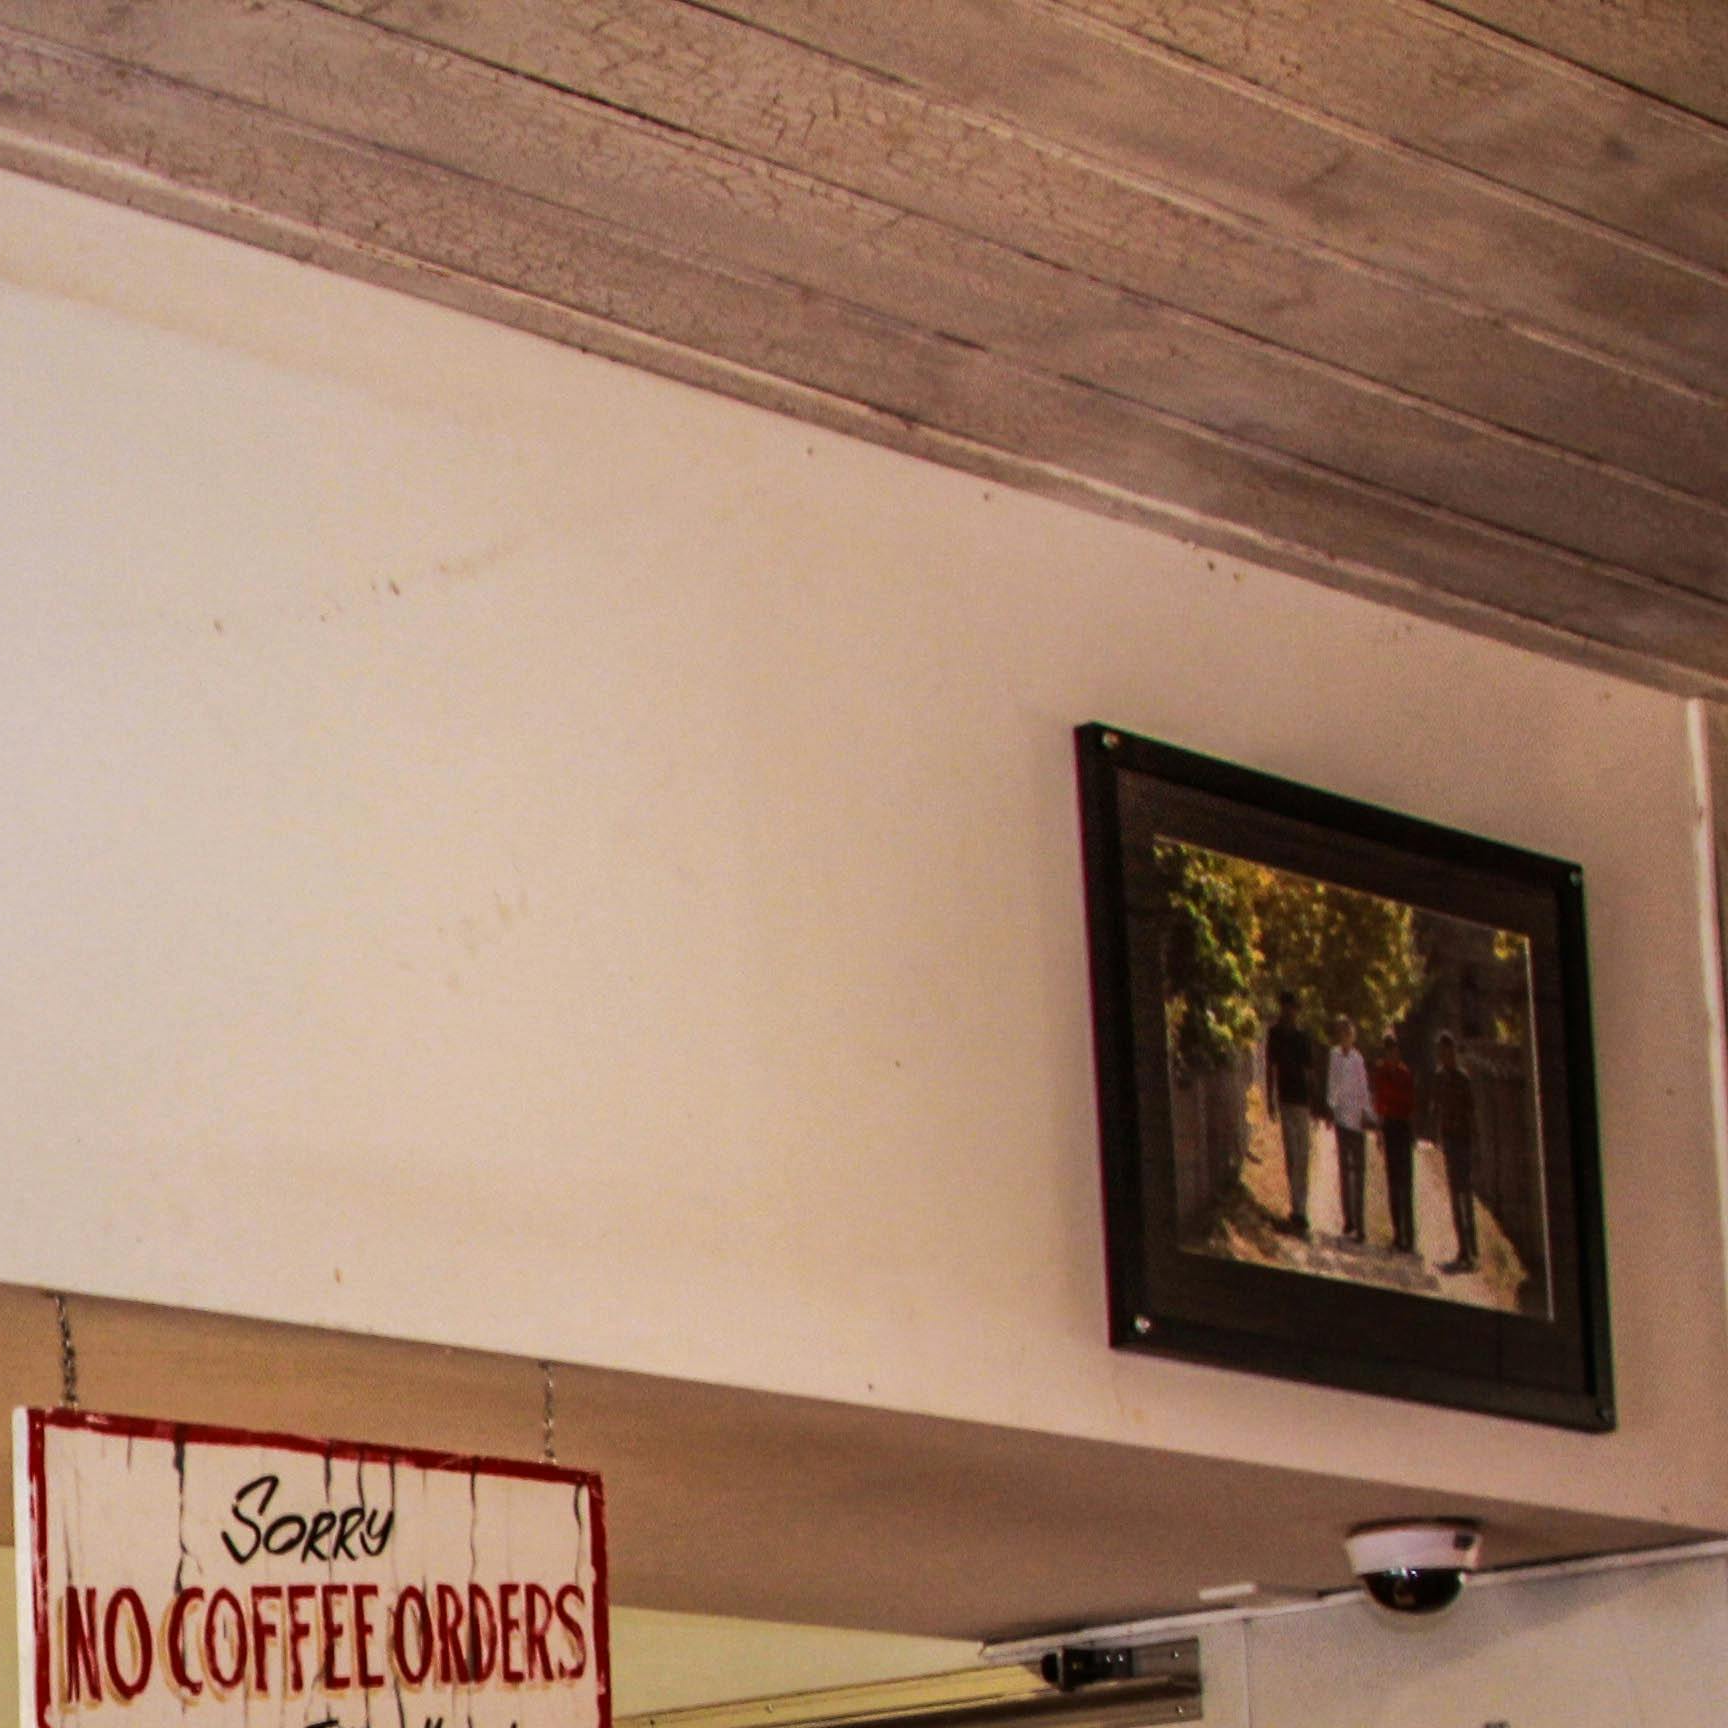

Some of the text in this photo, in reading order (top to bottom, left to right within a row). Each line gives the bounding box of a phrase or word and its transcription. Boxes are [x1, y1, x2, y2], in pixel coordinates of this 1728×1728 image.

[64, 1583, 587, 1704] NO COFFEE ORDERS
